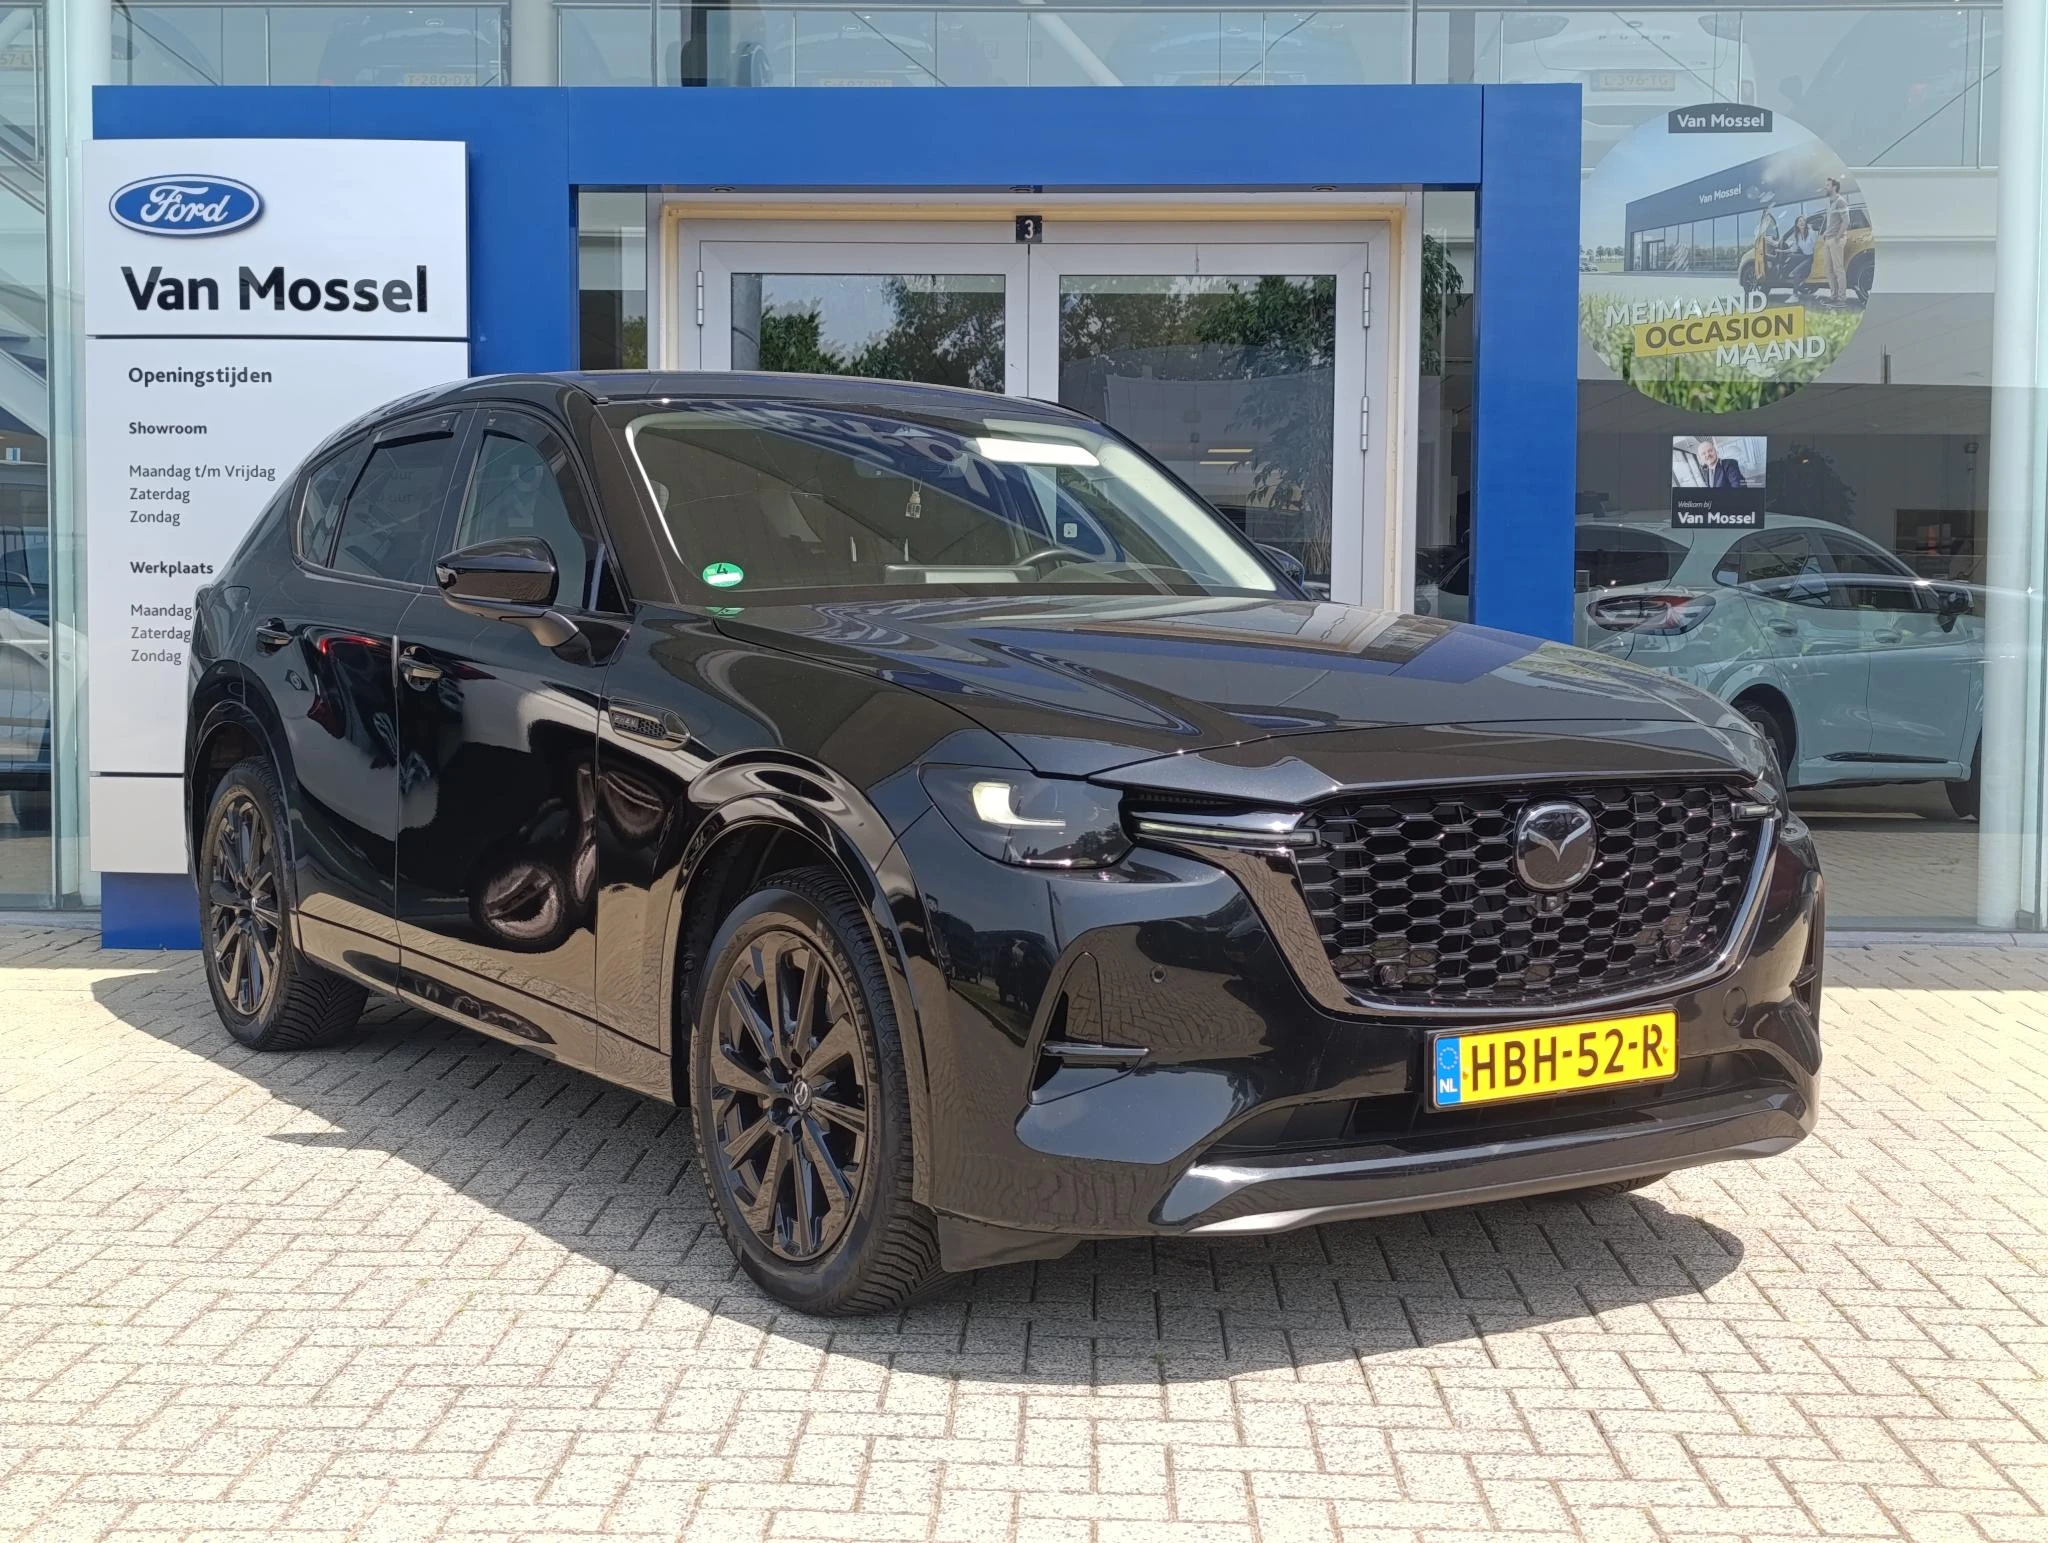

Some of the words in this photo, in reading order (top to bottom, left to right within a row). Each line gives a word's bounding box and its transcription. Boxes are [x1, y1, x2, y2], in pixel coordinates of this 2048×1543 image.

[1677, 114, 1706, 127] Van
[1711, 113, 1764, 127] Mossel
[1699, 194, 1713, 204] Van
[1714, 184, 1742, 200] Mossel
[140, 184, 231, 223] Ford
[1024, 219, 1034, 239] 3
[120, 266, 219, 311] Van
[238, 265, 428, 313] Mossel
[1606, 291, 1768, 328] MEIMAAND
[1645, 313, 1794, 349] OCCASION
[1716, 335, 1827, 368] MAAND
[128, 367, 273, 388] Openingstijden
[128, 421, 208, 435] Showroom
[129, 464, 191, 481] Maandag
[195, 464, 221, 478] t/m
[225, 464, 276, 481] Vrijdag
[129, 487, 191, 504] Zaterdag
[129, 510, 181, 526] Zondag
[1677, 511, 1704, 524] Van
[1707, 511, 1756, 524] Mossel
[130, 561, 214, 577] Werkplaats
[716, 564, 728, 574] 4
[130, 604, 193, 620] Maandag
[131, 626, 192, 643] Zaterdag
[131, 649, 182, 665] Zondag
[1471, 1023, 1664, 1092] HBH-52-R
[1439, 1078, 1458, 1093] NL
